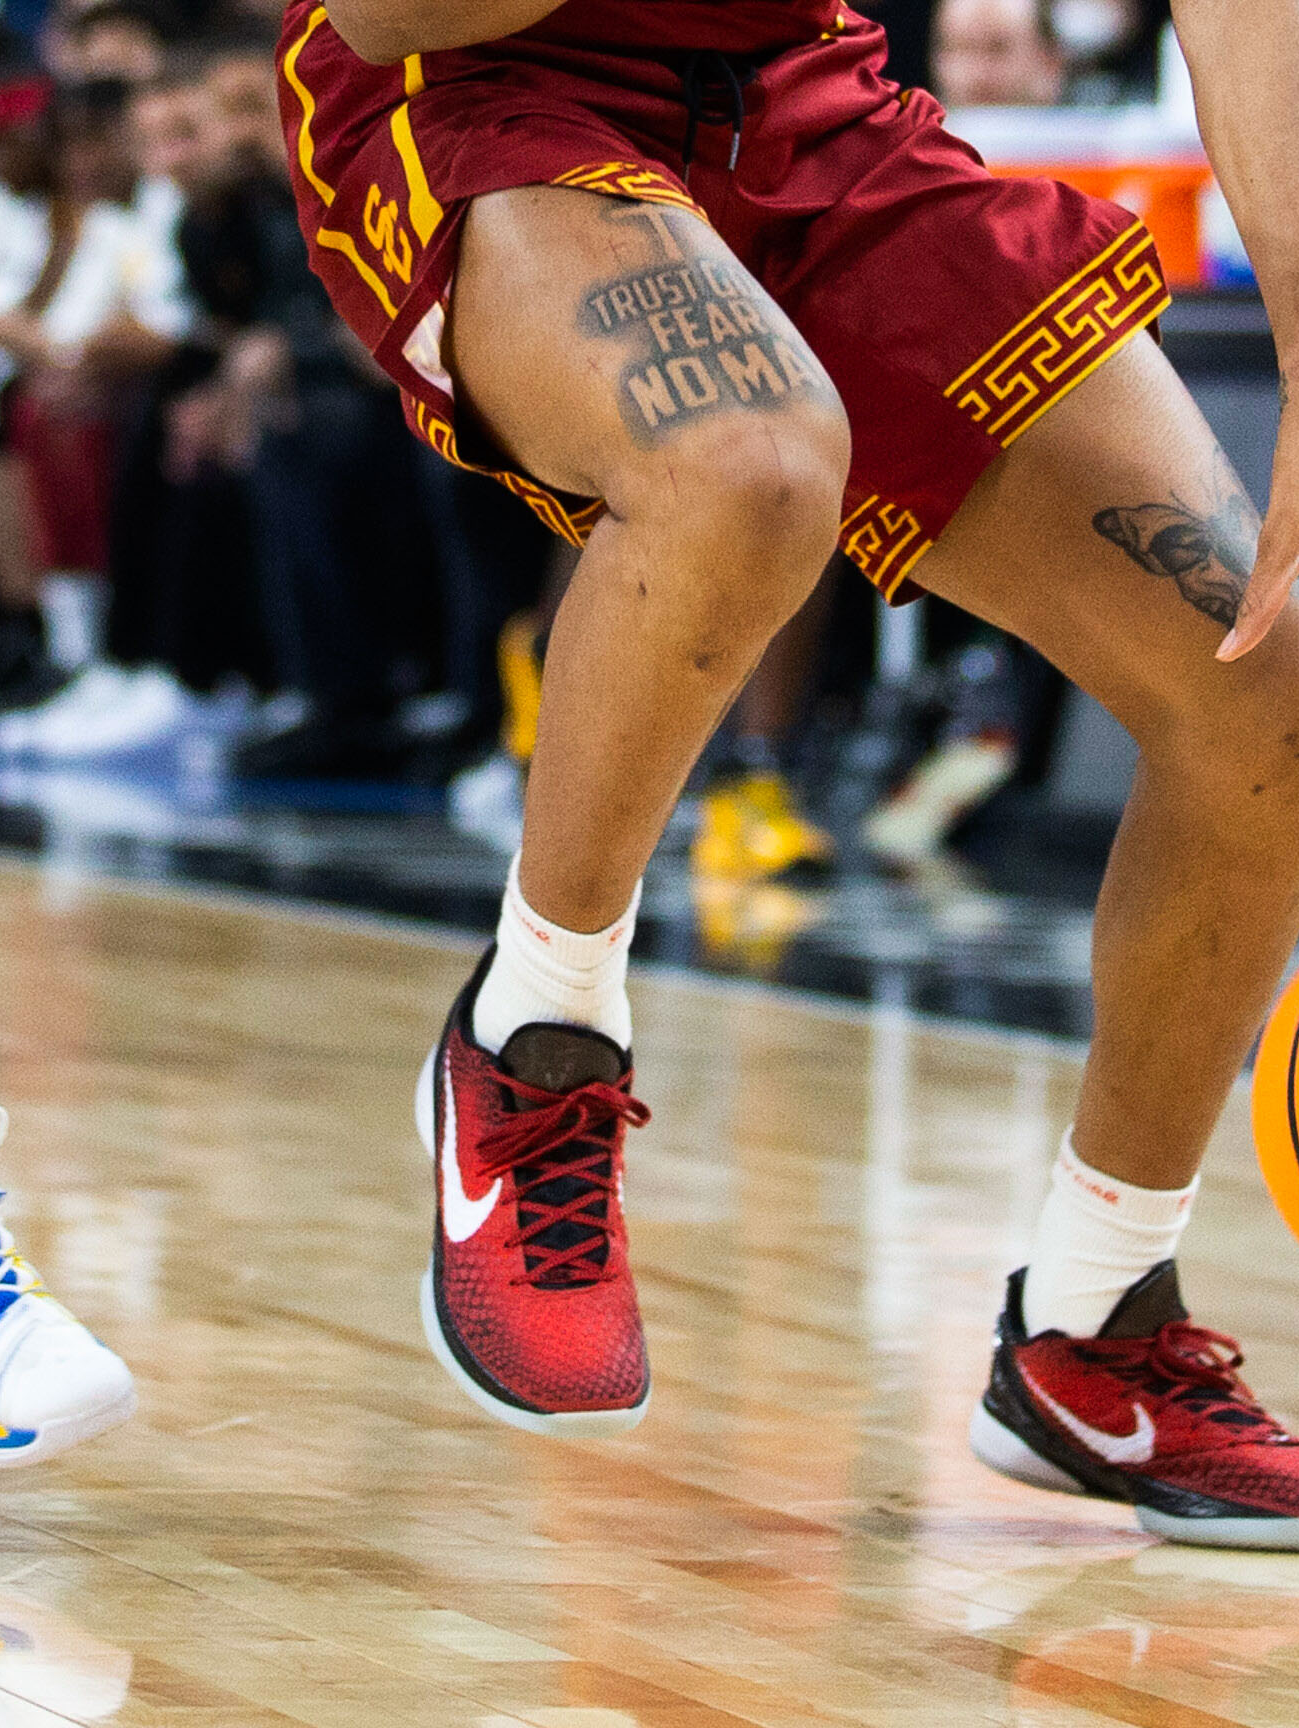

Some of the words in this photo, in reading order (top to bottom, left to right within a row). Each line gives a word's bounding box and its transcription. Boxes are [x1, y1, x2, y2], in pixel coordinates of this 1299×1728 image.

[589, 269, 699, 329] TRUST
[648, 297, 769, 353] FEAR
[627, 356, 719, 428] NO
[716, 338, 823, 403] MA
